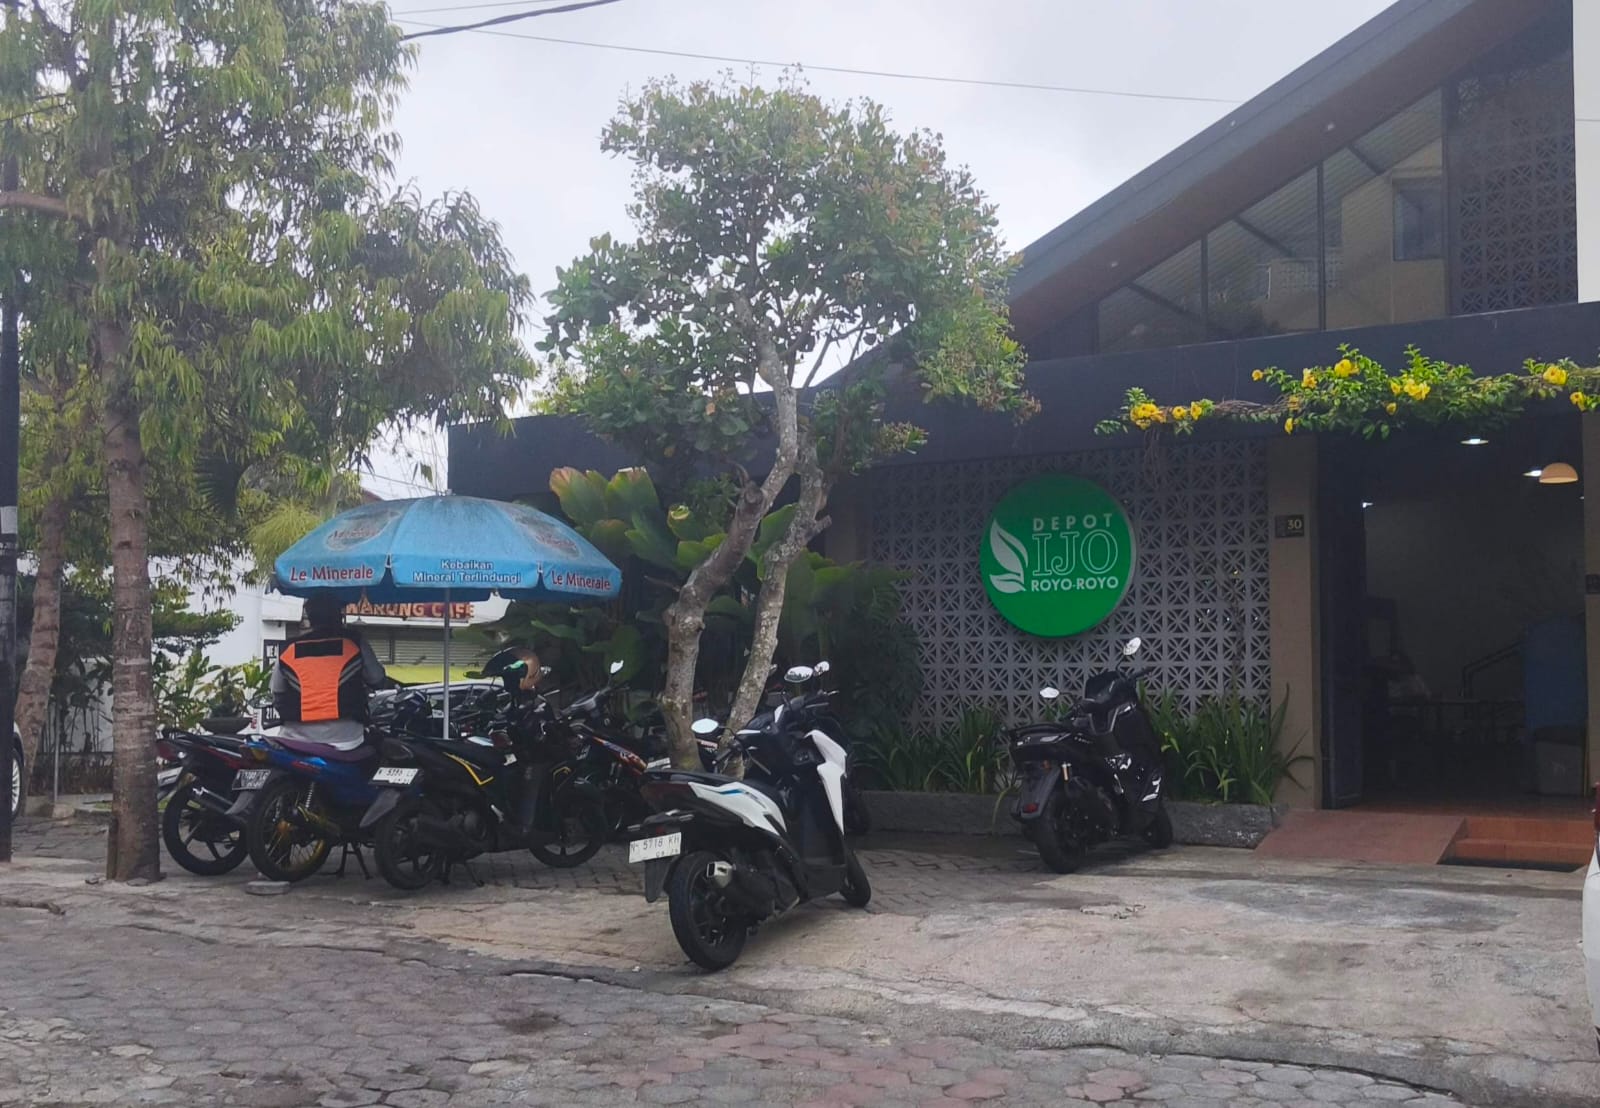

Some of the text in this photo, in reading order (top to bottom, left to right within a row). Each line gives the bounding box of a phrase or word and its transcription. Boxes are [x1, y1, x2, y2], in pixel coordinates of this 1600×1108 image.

[1033, 513, 1112, 531] DEPOT
[1032, 529, 1118, 576] IJO
[290, 565, 374, 582] Le Minerale
[441, 560, 494, 570] Kebaikan
[413, 571, 521, 584] Mineral Terlindungi
[551, 570, 611, 590] Le Minerale
[1031, 576, 1119, 592] ROYO-ROYO
